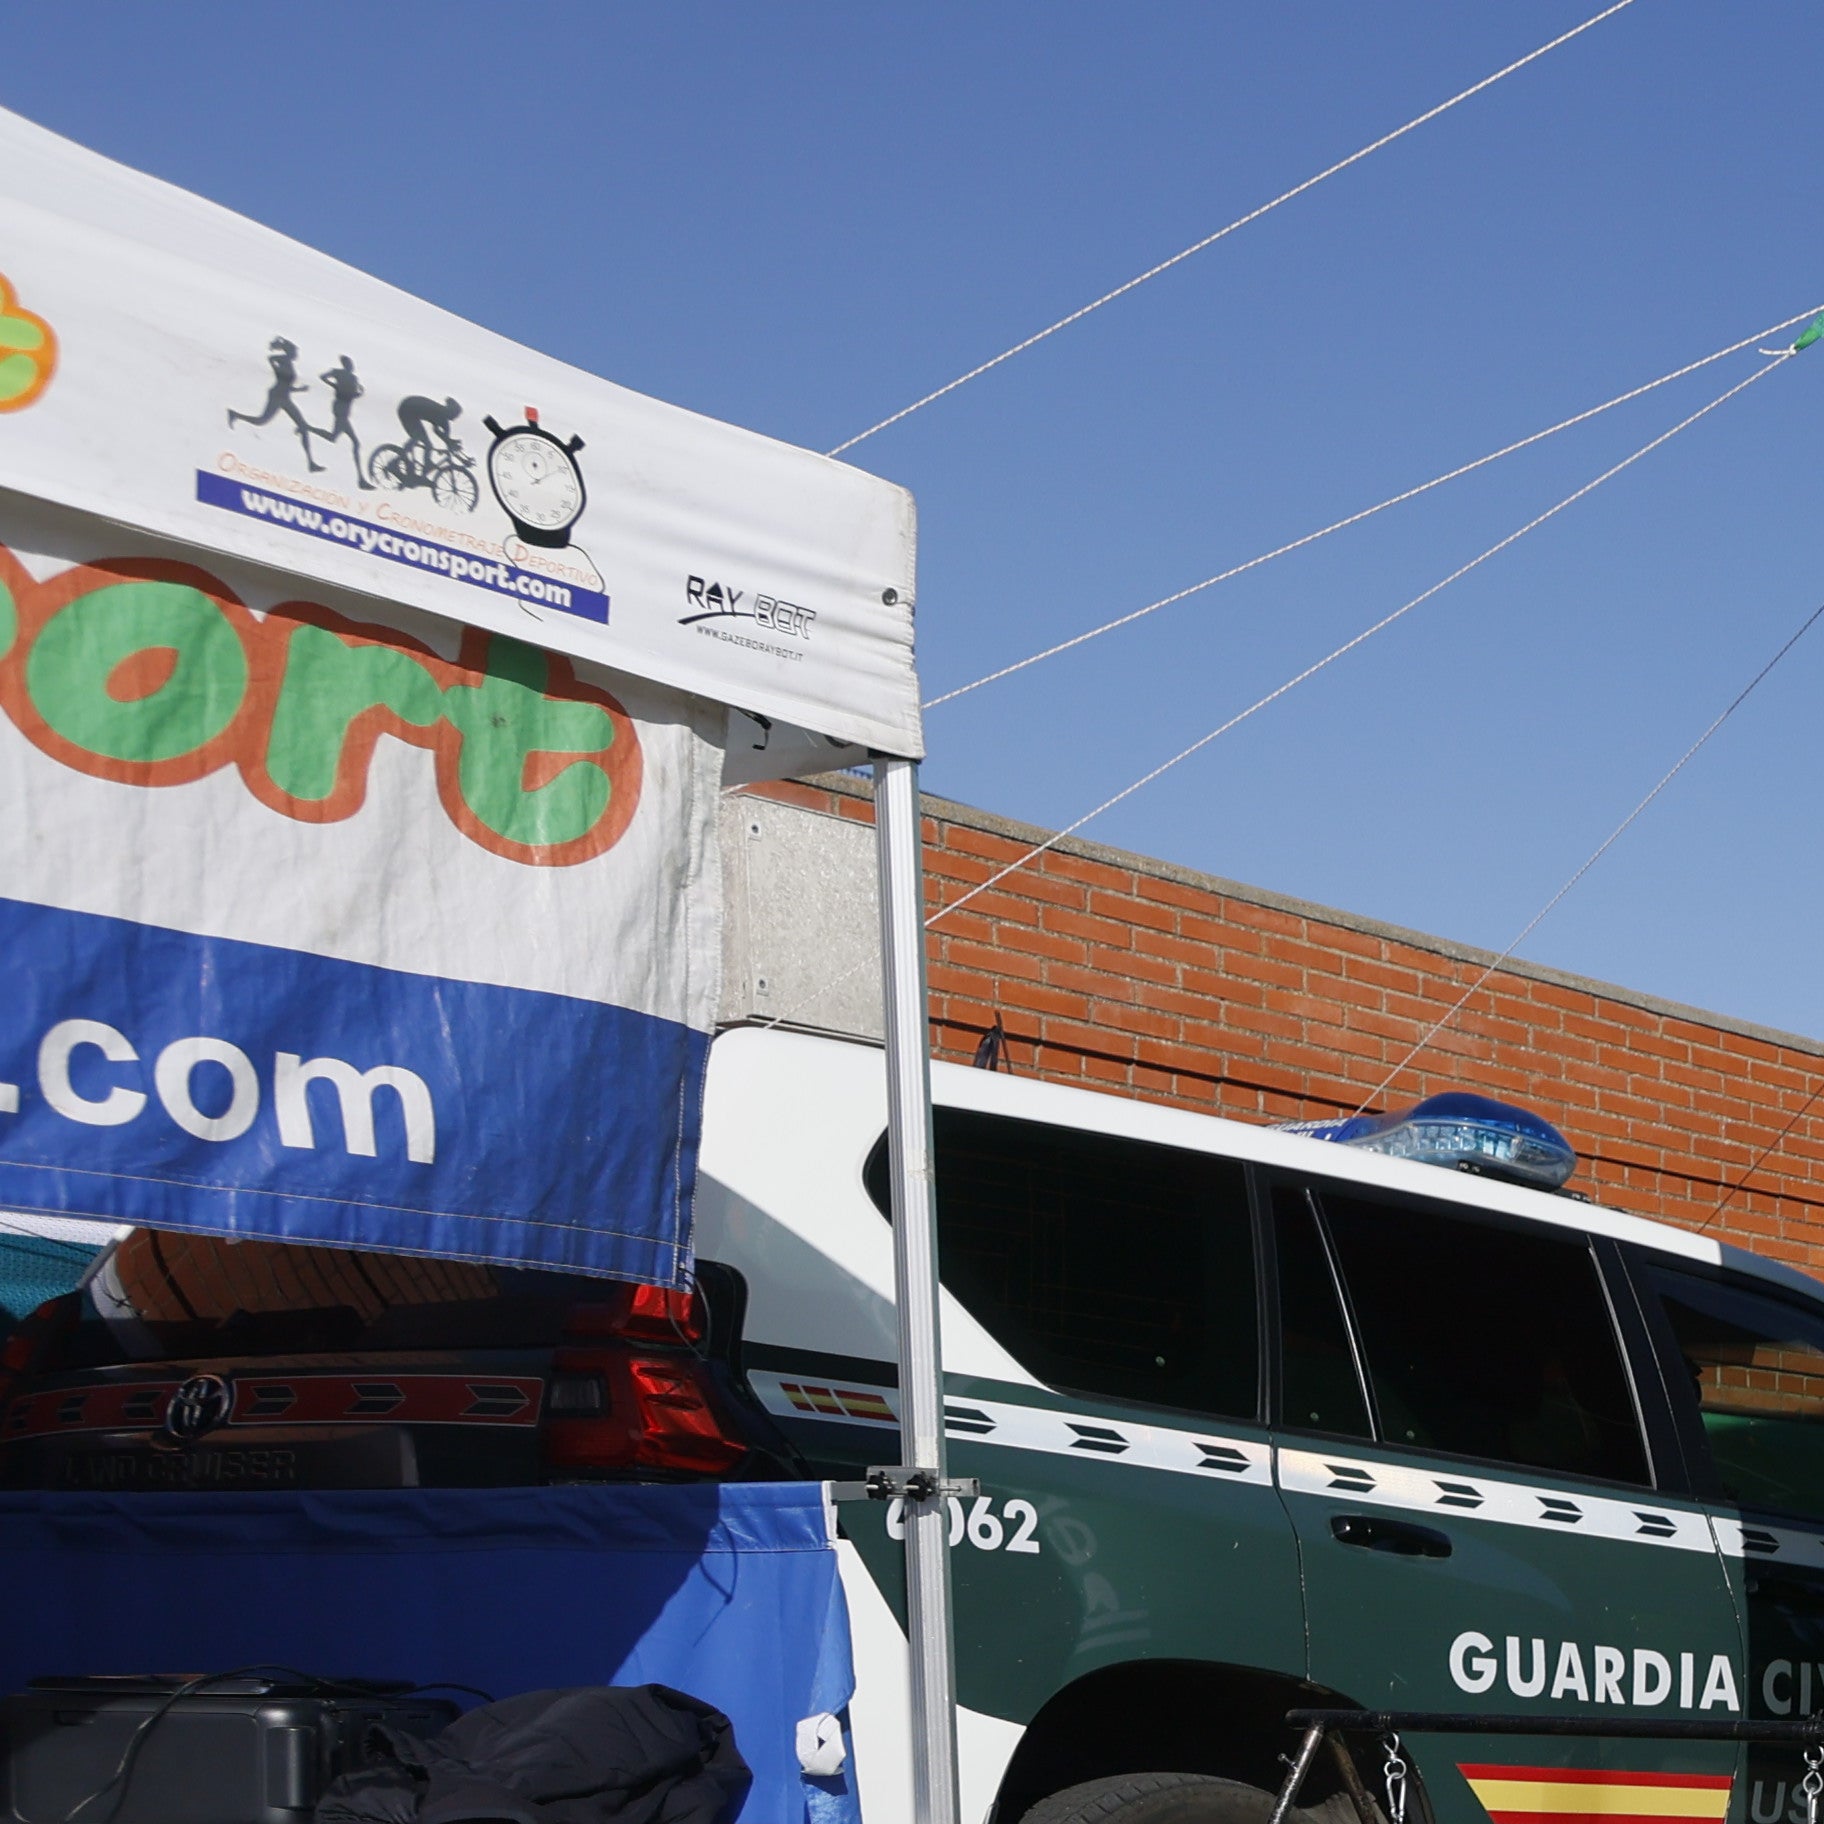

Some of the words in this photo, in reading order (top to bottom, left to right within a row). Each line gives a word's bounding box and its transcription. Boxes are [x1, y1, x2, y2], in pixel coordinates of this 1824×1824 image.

[240, 489, 573, 609] www.orycronsport.com
[687, 574, 744, 617] RAY
[0, 557, 643, 867] ort
[1449, 1630, 1741, 1713] GUARDIA
